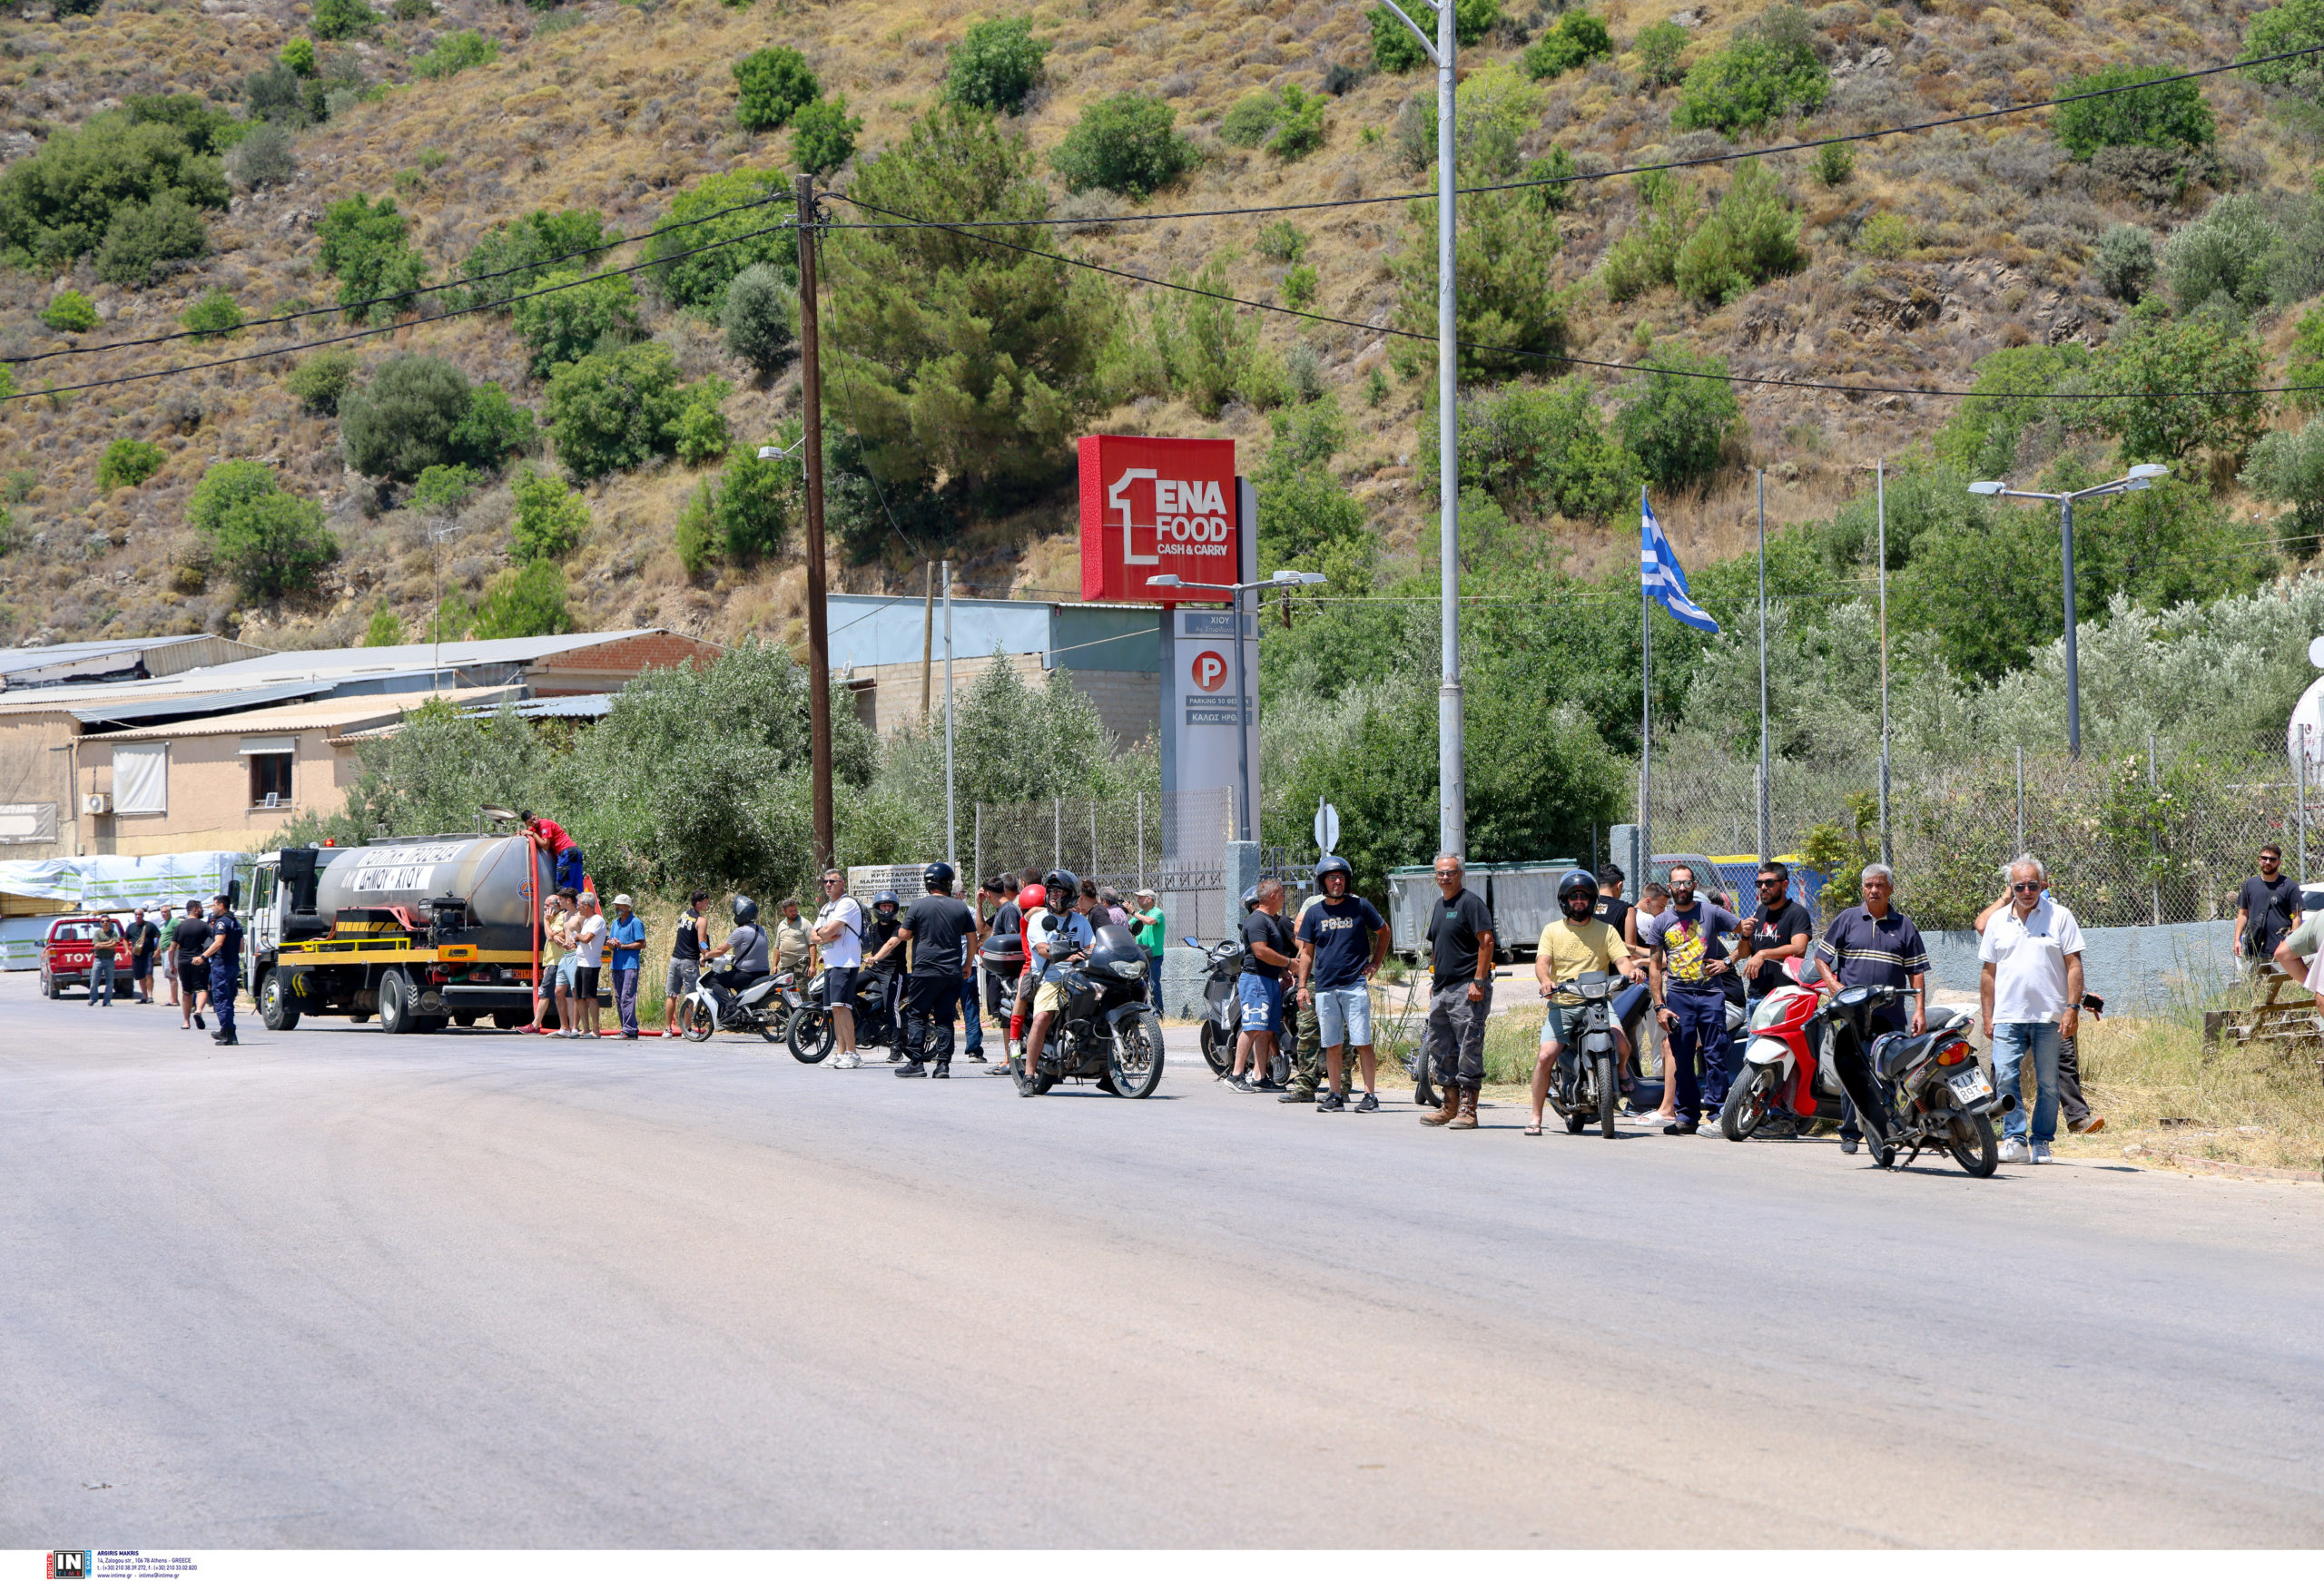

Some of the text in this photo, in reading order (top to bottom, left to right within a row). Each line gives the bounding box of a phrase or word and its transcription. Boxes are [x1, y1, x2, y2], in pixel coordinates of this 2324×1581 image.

[1155, 480, 1226, 515] ENA
[1156, 515, 1227, 542] FOOD
[1210, 616, 1229, 624] ΧΙΟΥ
[1202, 657, 1222, 687] P
[1192, 713, 1220, 722] ΚΑΛΩΣ
[359, 868, 392, 889] ΔΗΜΟΥ
[395, 867, 424, 889] ΧΙΟΥ
[64, 952, 123, 962] TOYA
[1960, 1085, 1983, 1101] 893
